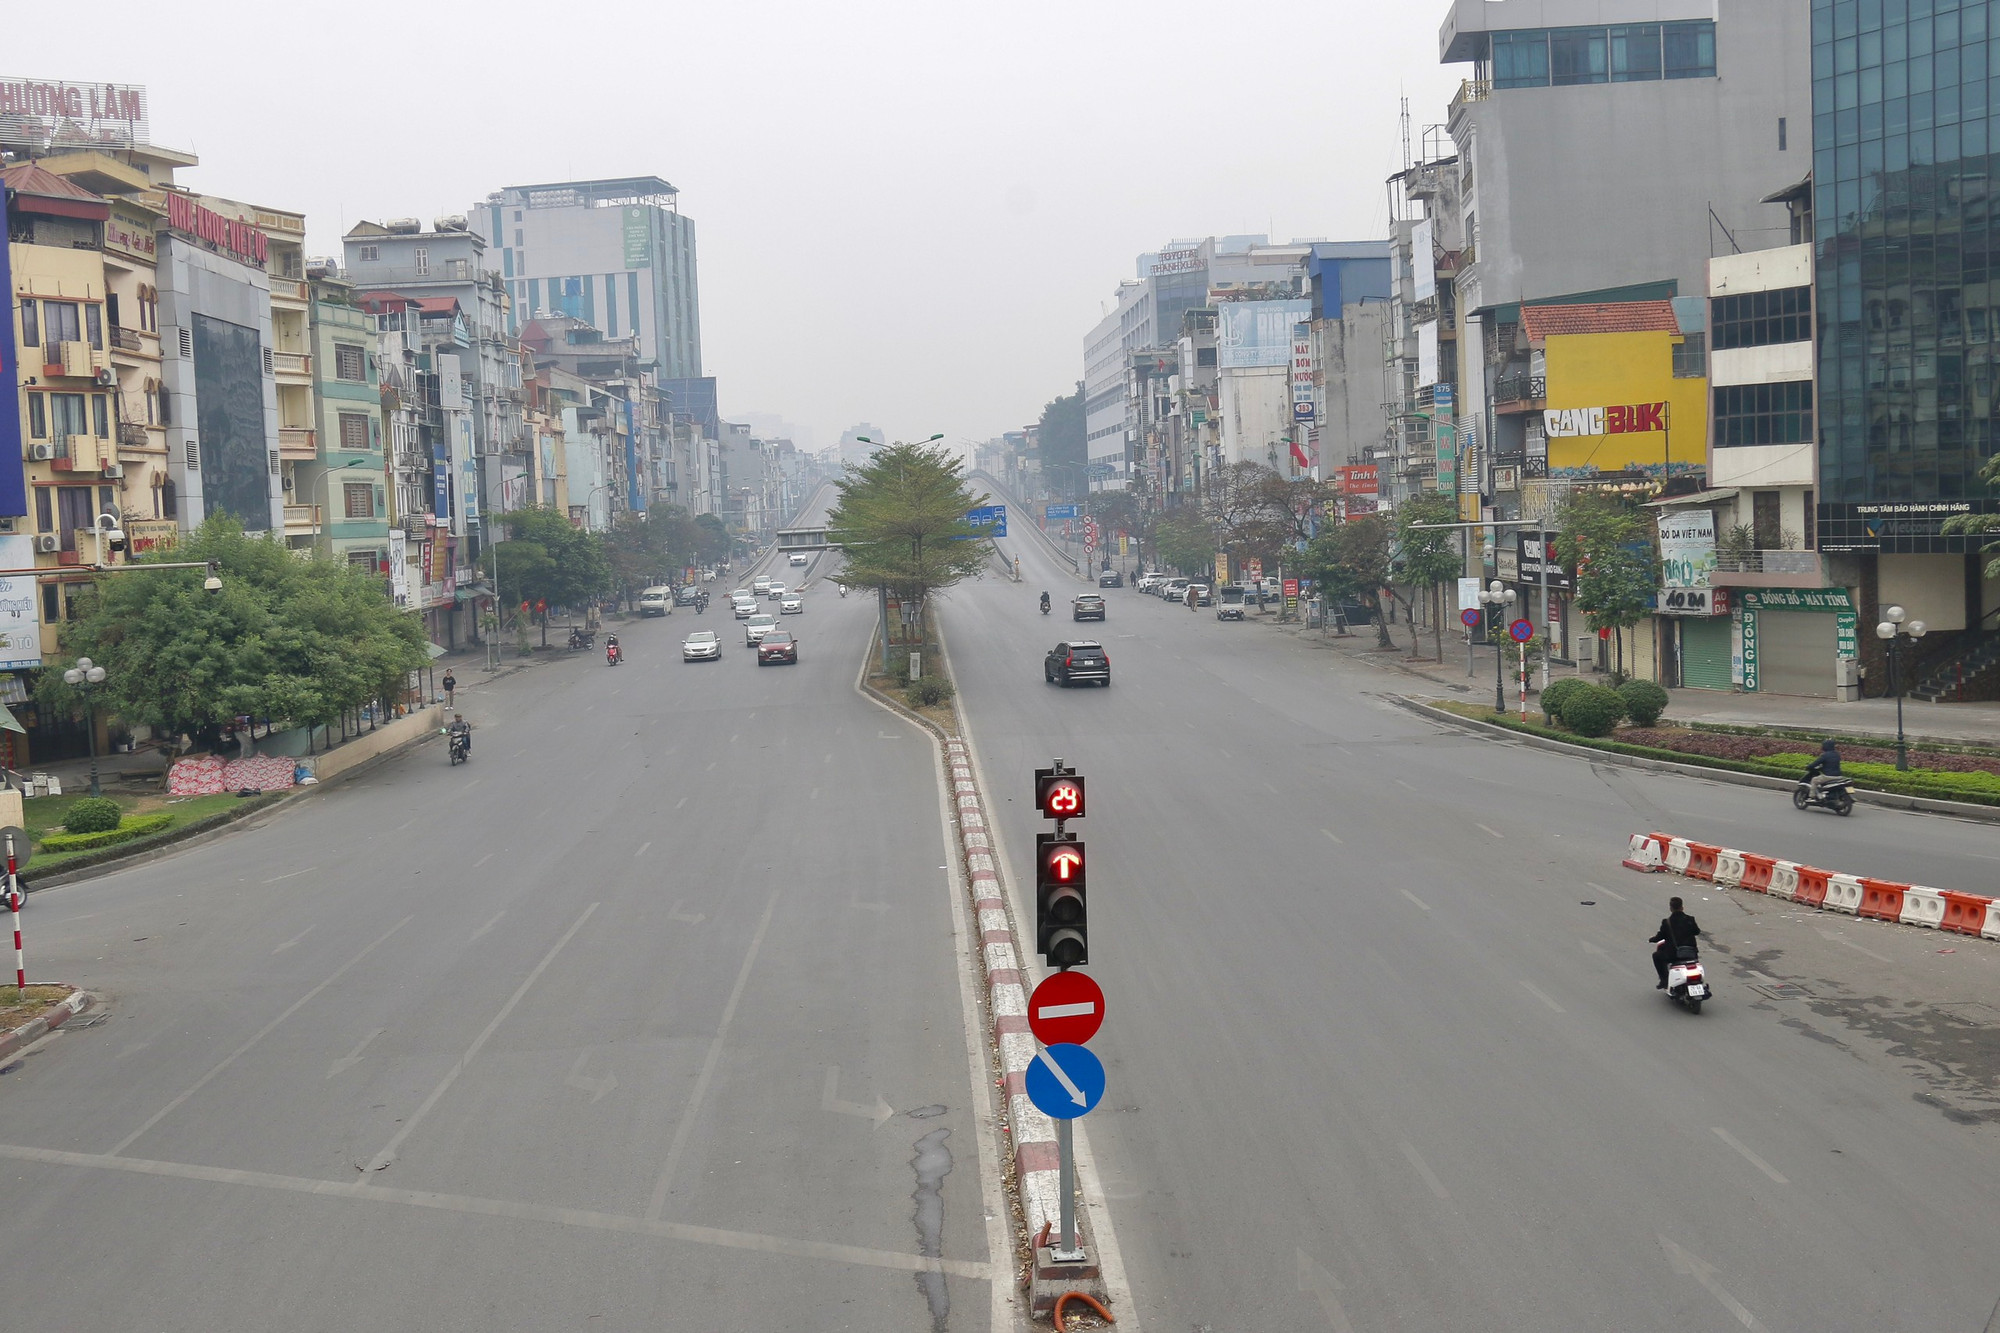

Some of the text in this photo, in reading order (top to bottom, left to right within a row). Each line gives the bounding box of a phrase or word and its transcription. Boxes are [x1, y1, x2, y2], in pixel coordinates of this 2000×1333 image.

[89, 83, 141, 120] LÂM
[168, 192, 194, 234] NHA
[196, 205, 227, 248] KHOA
[229, 215, 252, 262] VIỆT
[254, 222, 269, 263] ÚC
[1160, 250, 1197, 260] TOYOTA
[1151, 259, 1208, 274] THANH XUÂN
[1295, 342, 1309, 354] MÁY
[1296, 358, 1310, 368] BƠM
[1294, 369, 1312, 382] NƯỚC
[1437, 385, 1450, 393] 375
[1605, 402, 1664, 434] BUK
[1880, 503, 1893, 512] TÂM
[1894, 503, 1908, 512] BẢO
[1910, 503, 1928, 511] HÀNH
[1929, 503, 1949, 511] CHÍNH
[1950, 503, 1970, 511] HÃNG
[1661, 526, 1713, 539] ĐỒ DA VIỆT NAM
[1666, 589, 1706, 608] ÁO DA
[1760, 588, 1786, 604] ĐỒNG
[1787, 588, 1800, 604] HỒ
[1804, 591, 1824, 606] MÁY
[1825, 591, 1849, 607] TÍNH
[1714, 604, 1728, 613] DA
[1744, 612, 1755, 660] ĐỒNG
[1745, 663, 1756, 688] HỒ
[1051, 786, 1077, 810] 29
